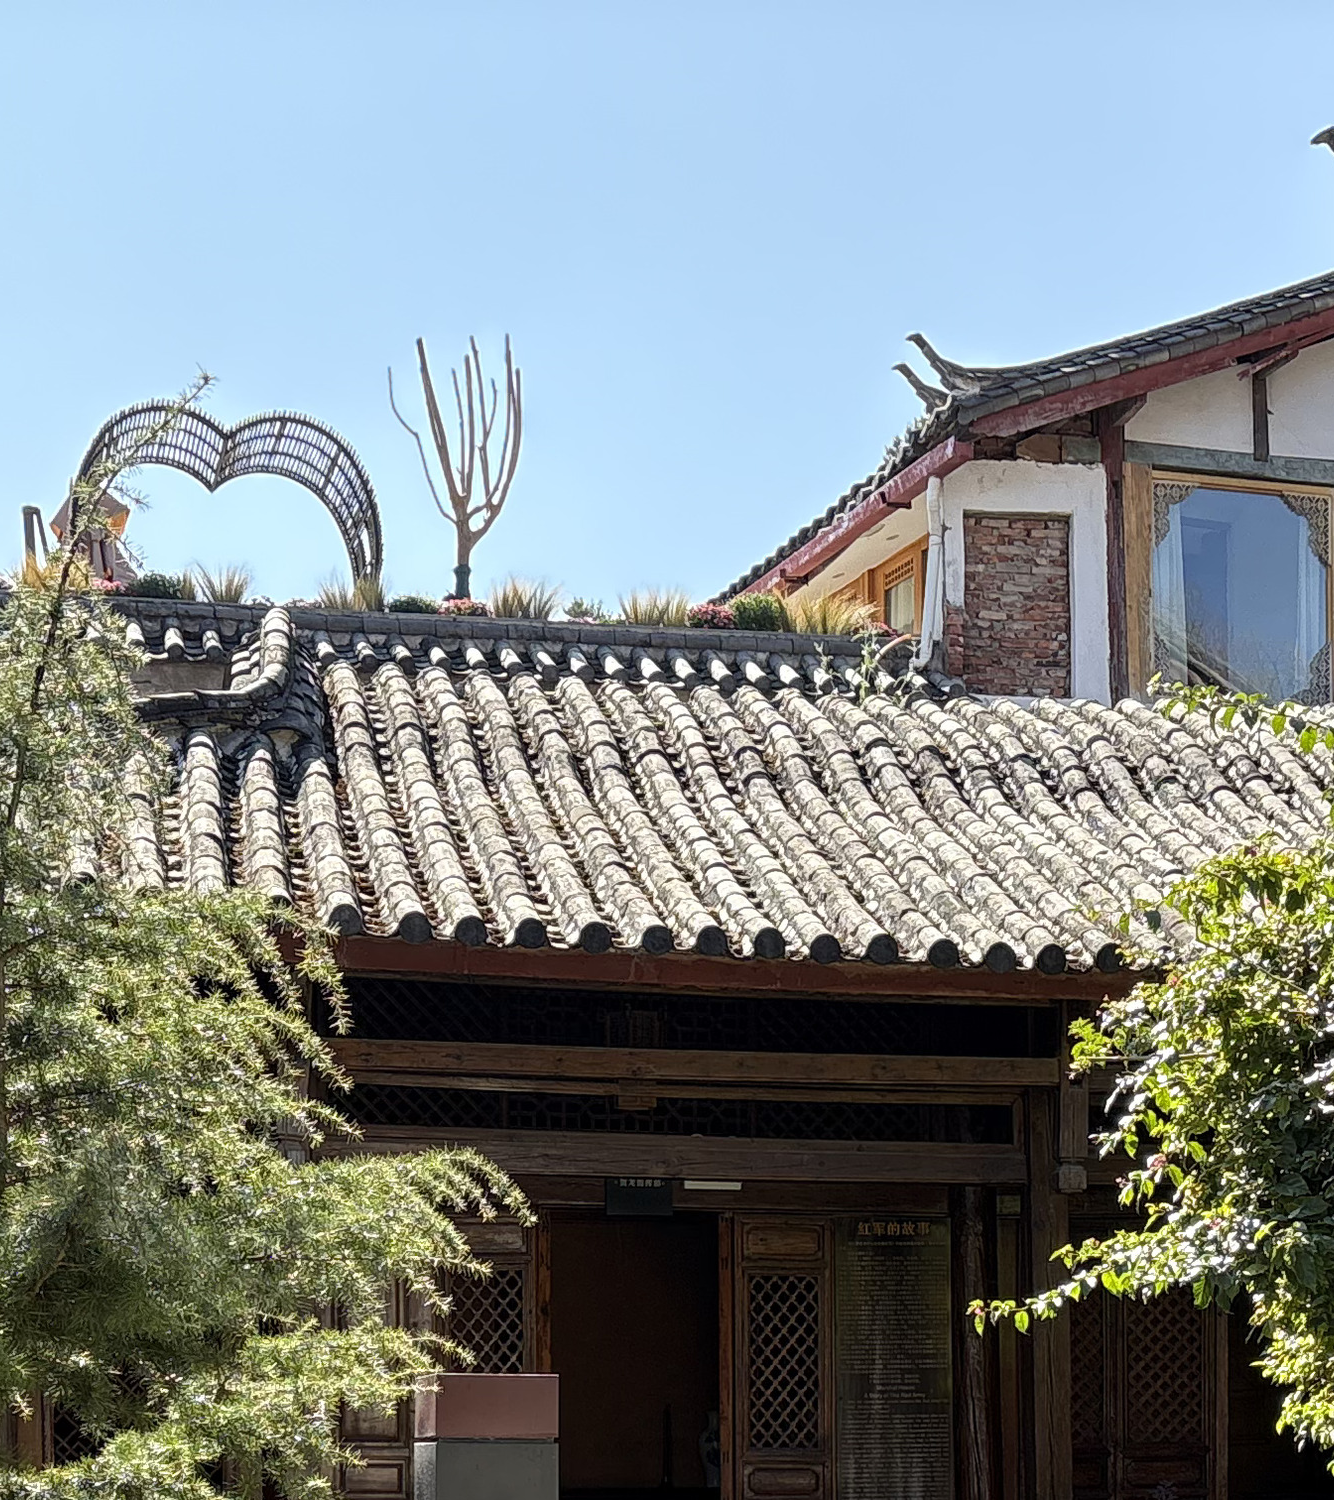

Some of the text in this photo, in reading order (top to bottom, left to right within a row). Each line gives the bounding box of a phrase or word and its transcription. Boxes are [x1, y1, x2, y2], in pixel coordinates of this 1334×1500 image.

[858, 1221, 931, 1237] 红军的故事
